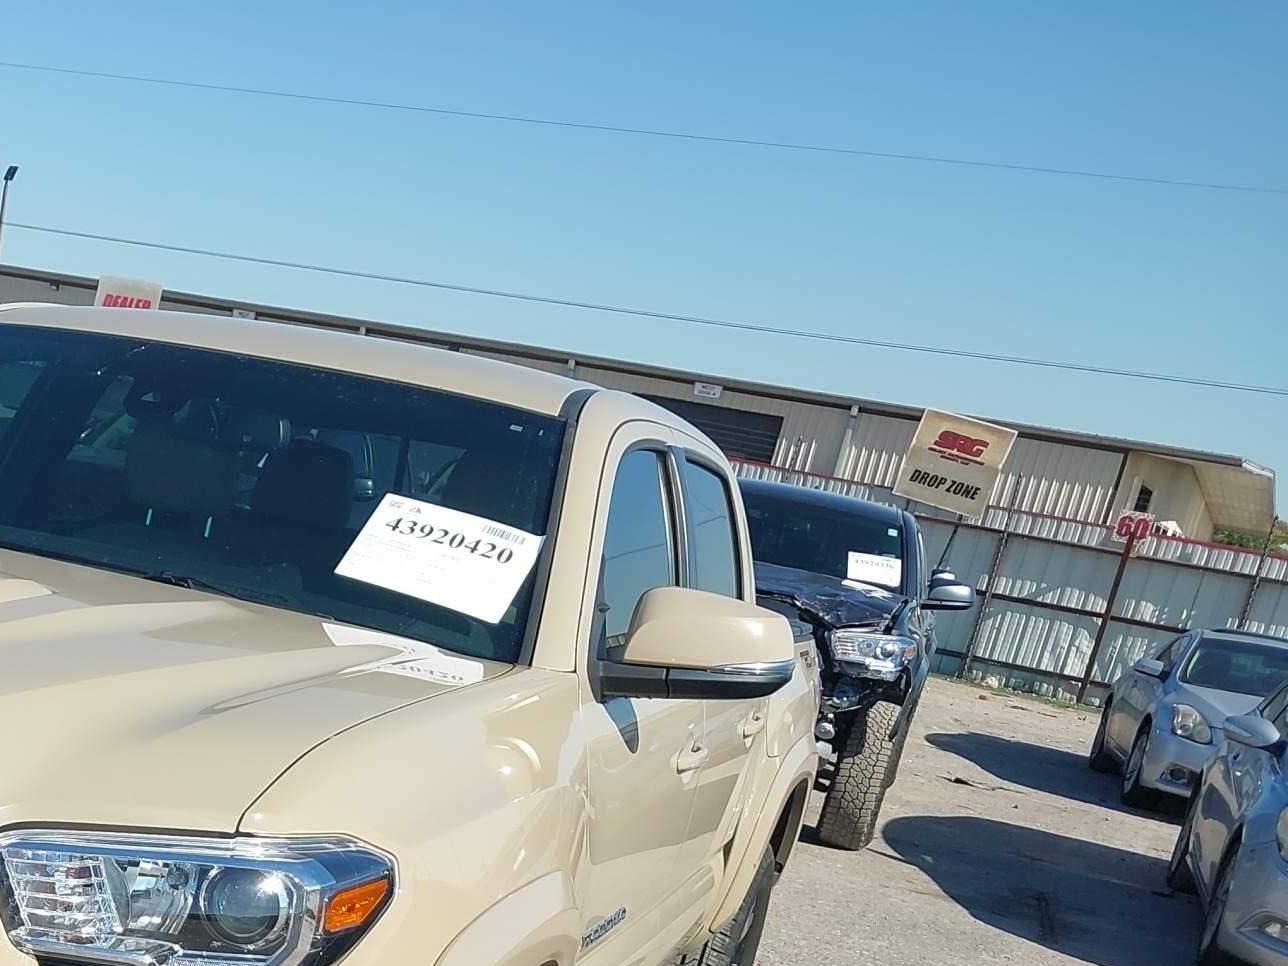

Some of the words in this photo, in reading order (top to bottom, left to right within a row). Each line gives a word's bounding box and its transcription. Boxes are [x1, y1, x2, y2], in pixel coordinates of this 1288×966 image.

[102, 294, 152, 309] DEALER
[909, 469, 948, 489] DROP
[945, 480, 981, 500] ZONE
[385, 517, 513, 564] 43920420
[1116, 515, 1150, 540] 60
